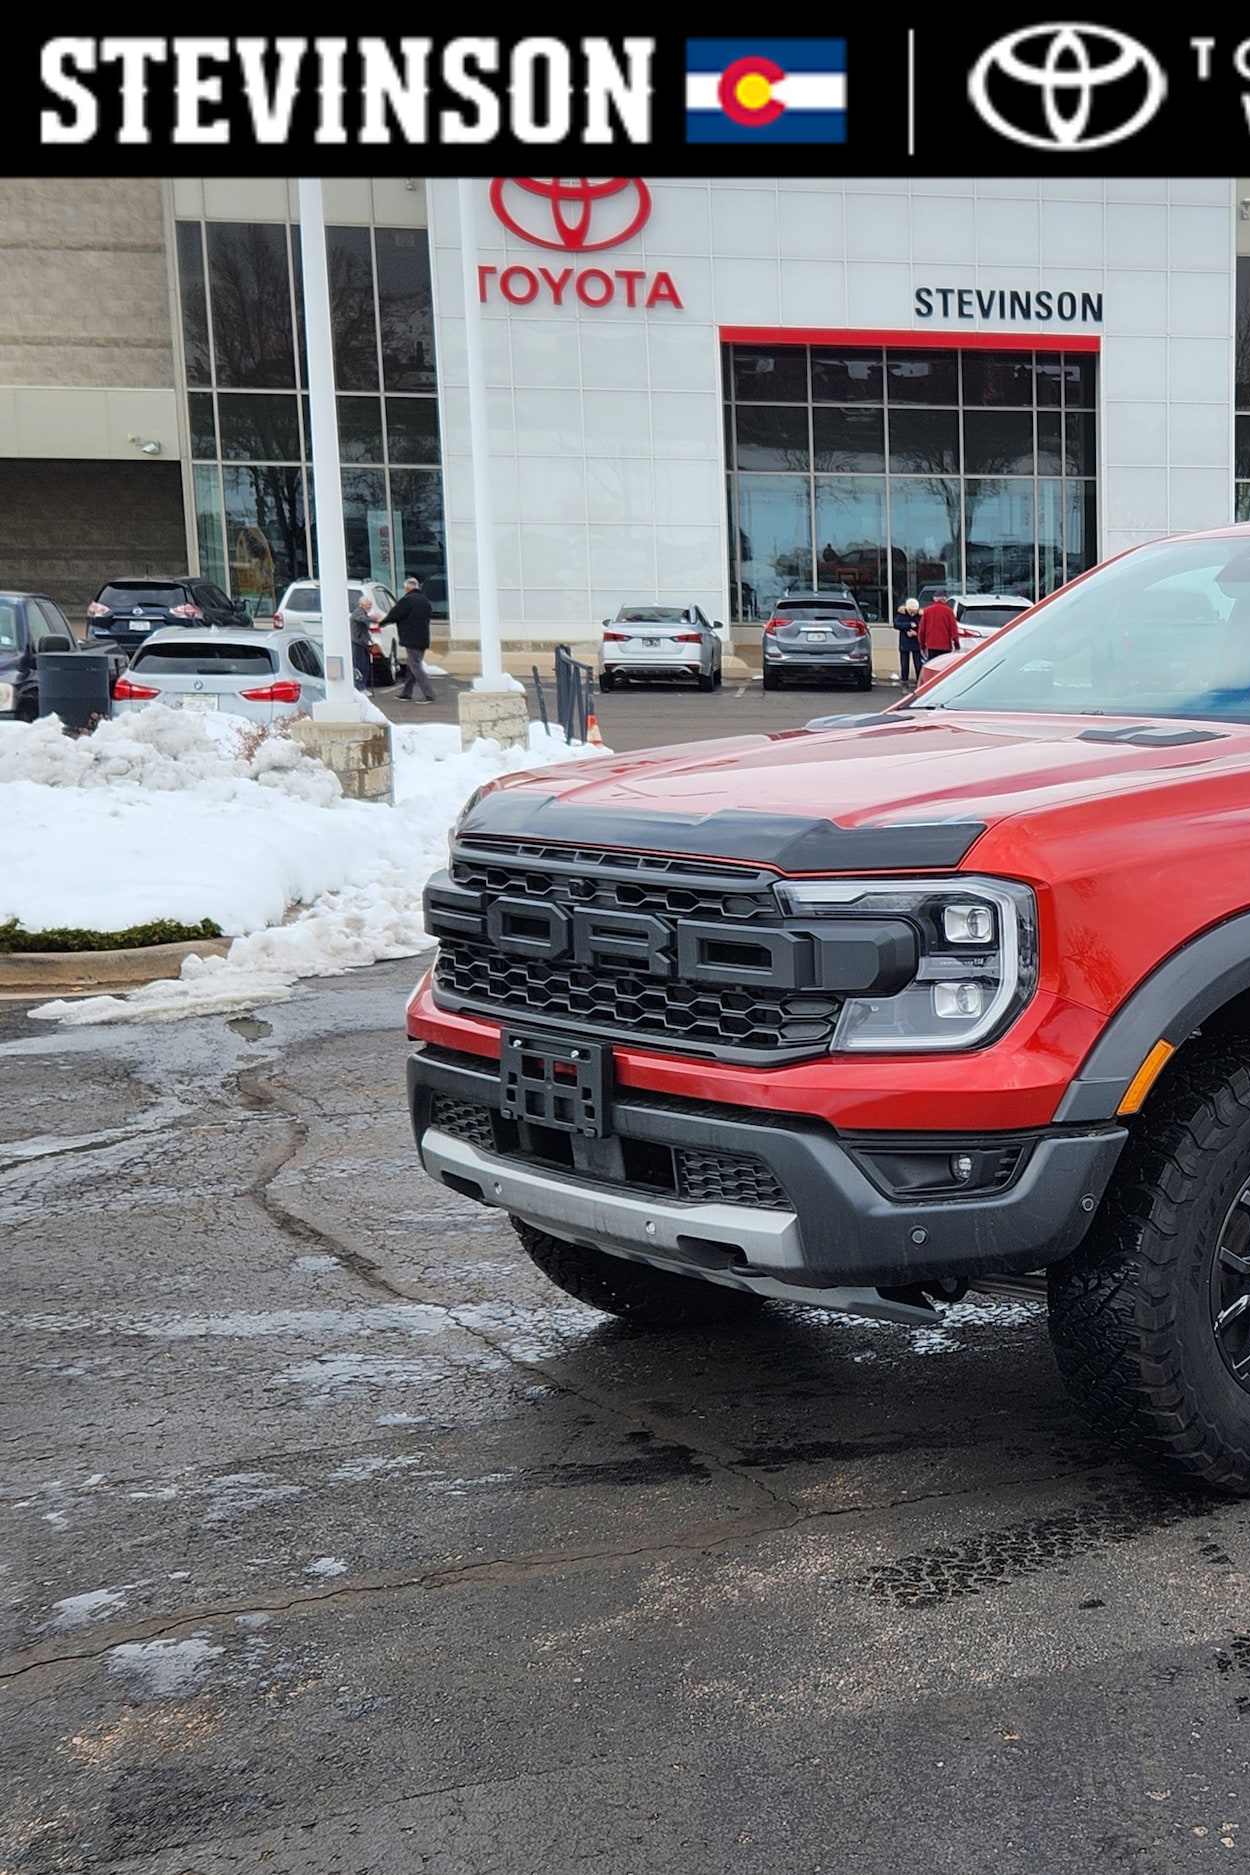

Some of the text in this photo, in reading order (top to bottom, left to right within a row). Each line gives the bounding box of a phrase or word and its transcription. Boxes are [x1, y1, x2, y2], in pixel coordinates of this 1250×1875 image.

[478, 264, 684, 309] TOYOTA
[914, 287, 1104, 323] STEVINSON
[424, 877, 804, 989] FORD
